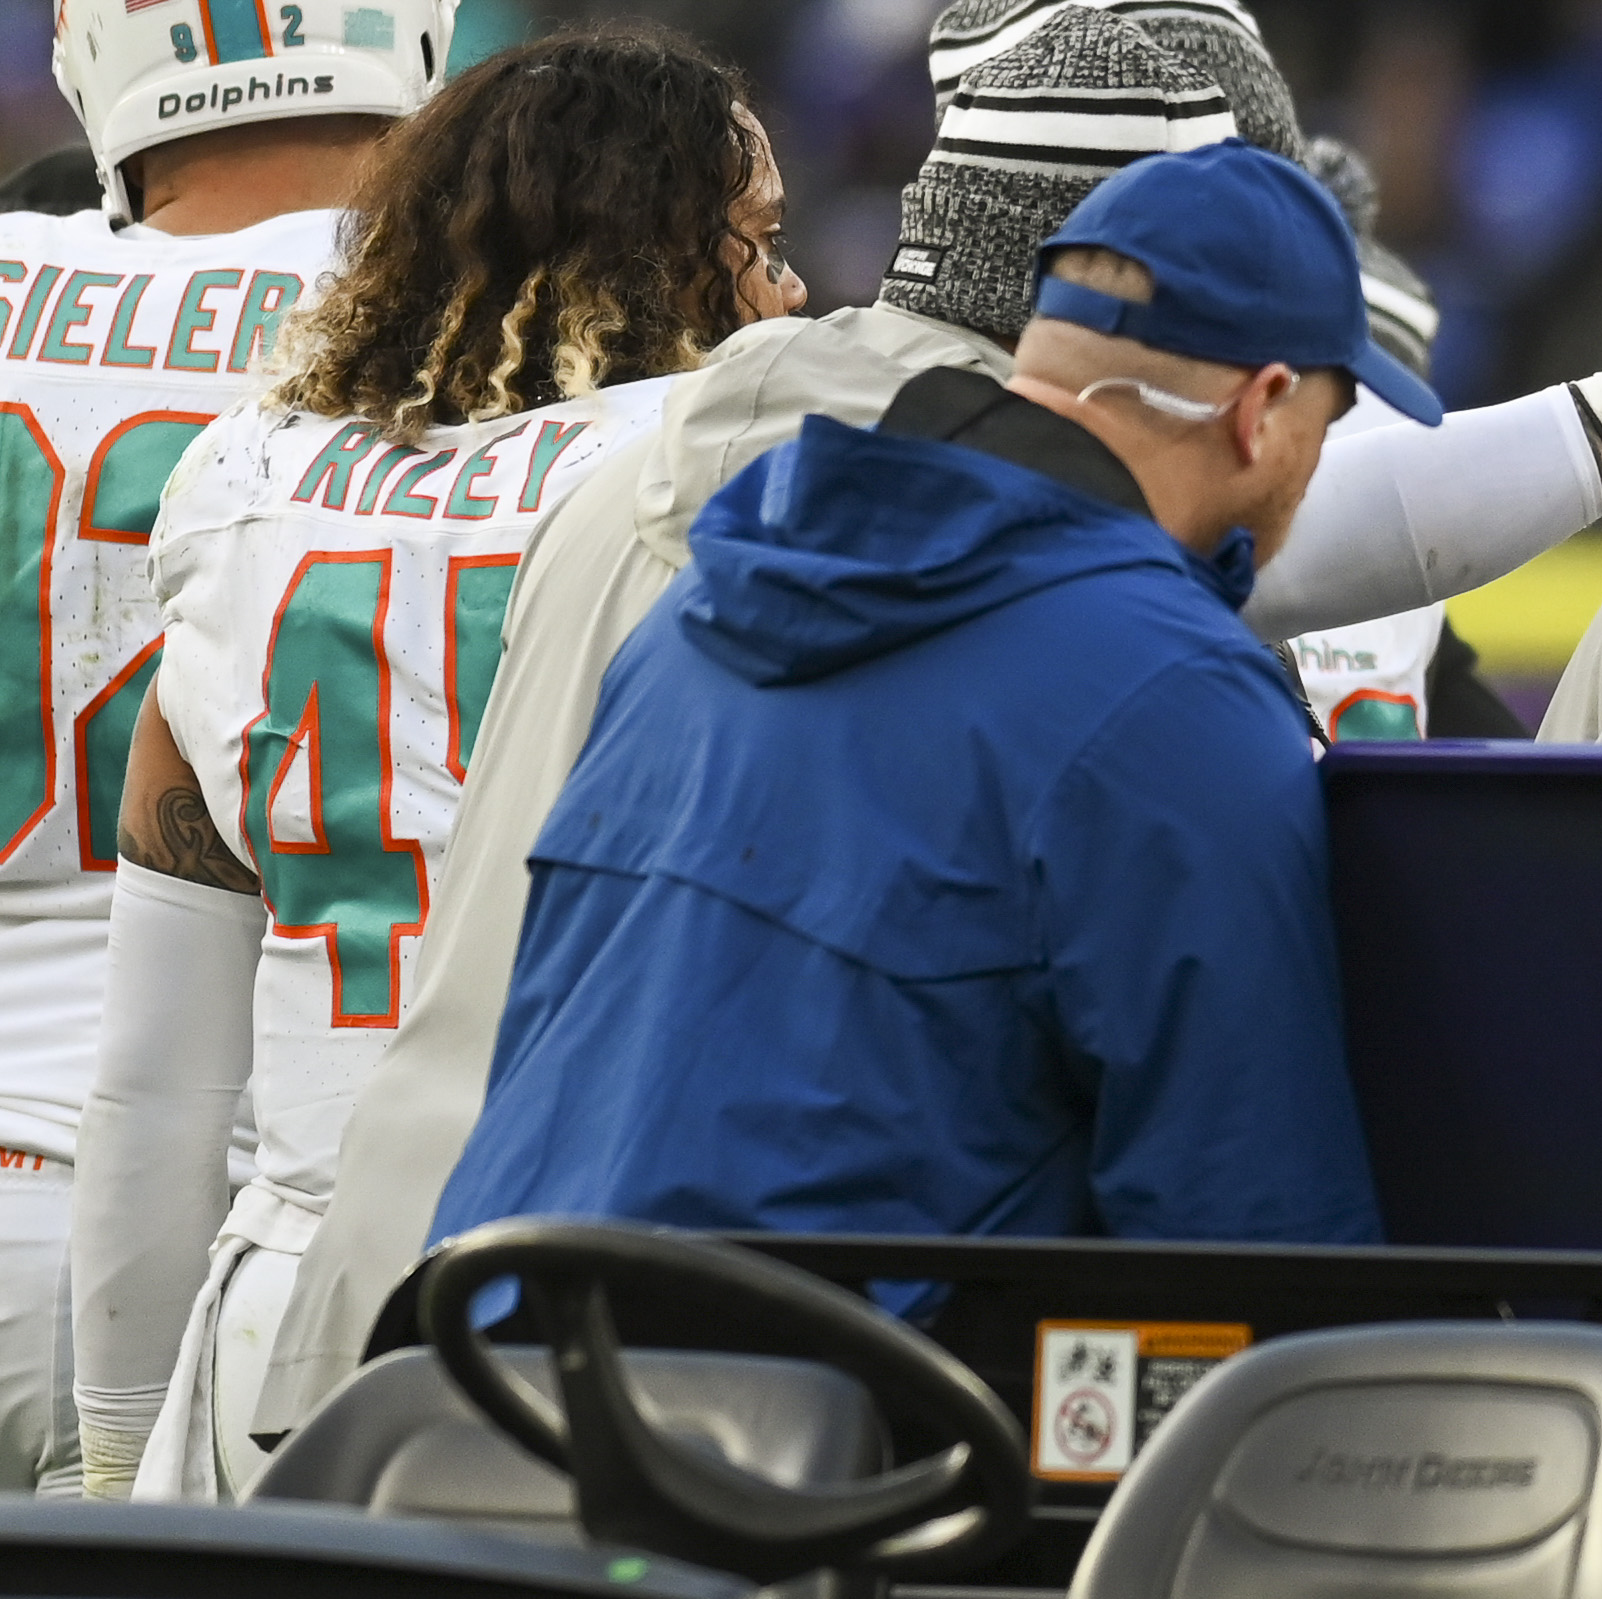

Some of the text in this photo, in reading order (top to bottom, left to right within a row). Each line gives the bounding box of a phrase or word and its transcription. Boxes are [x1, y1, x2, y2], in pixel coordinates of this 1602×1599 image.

[280, 4, 305, 47] 2
[157, 73, 334, 119] Dolphins
[290, 419, 594, 521] RILEY
